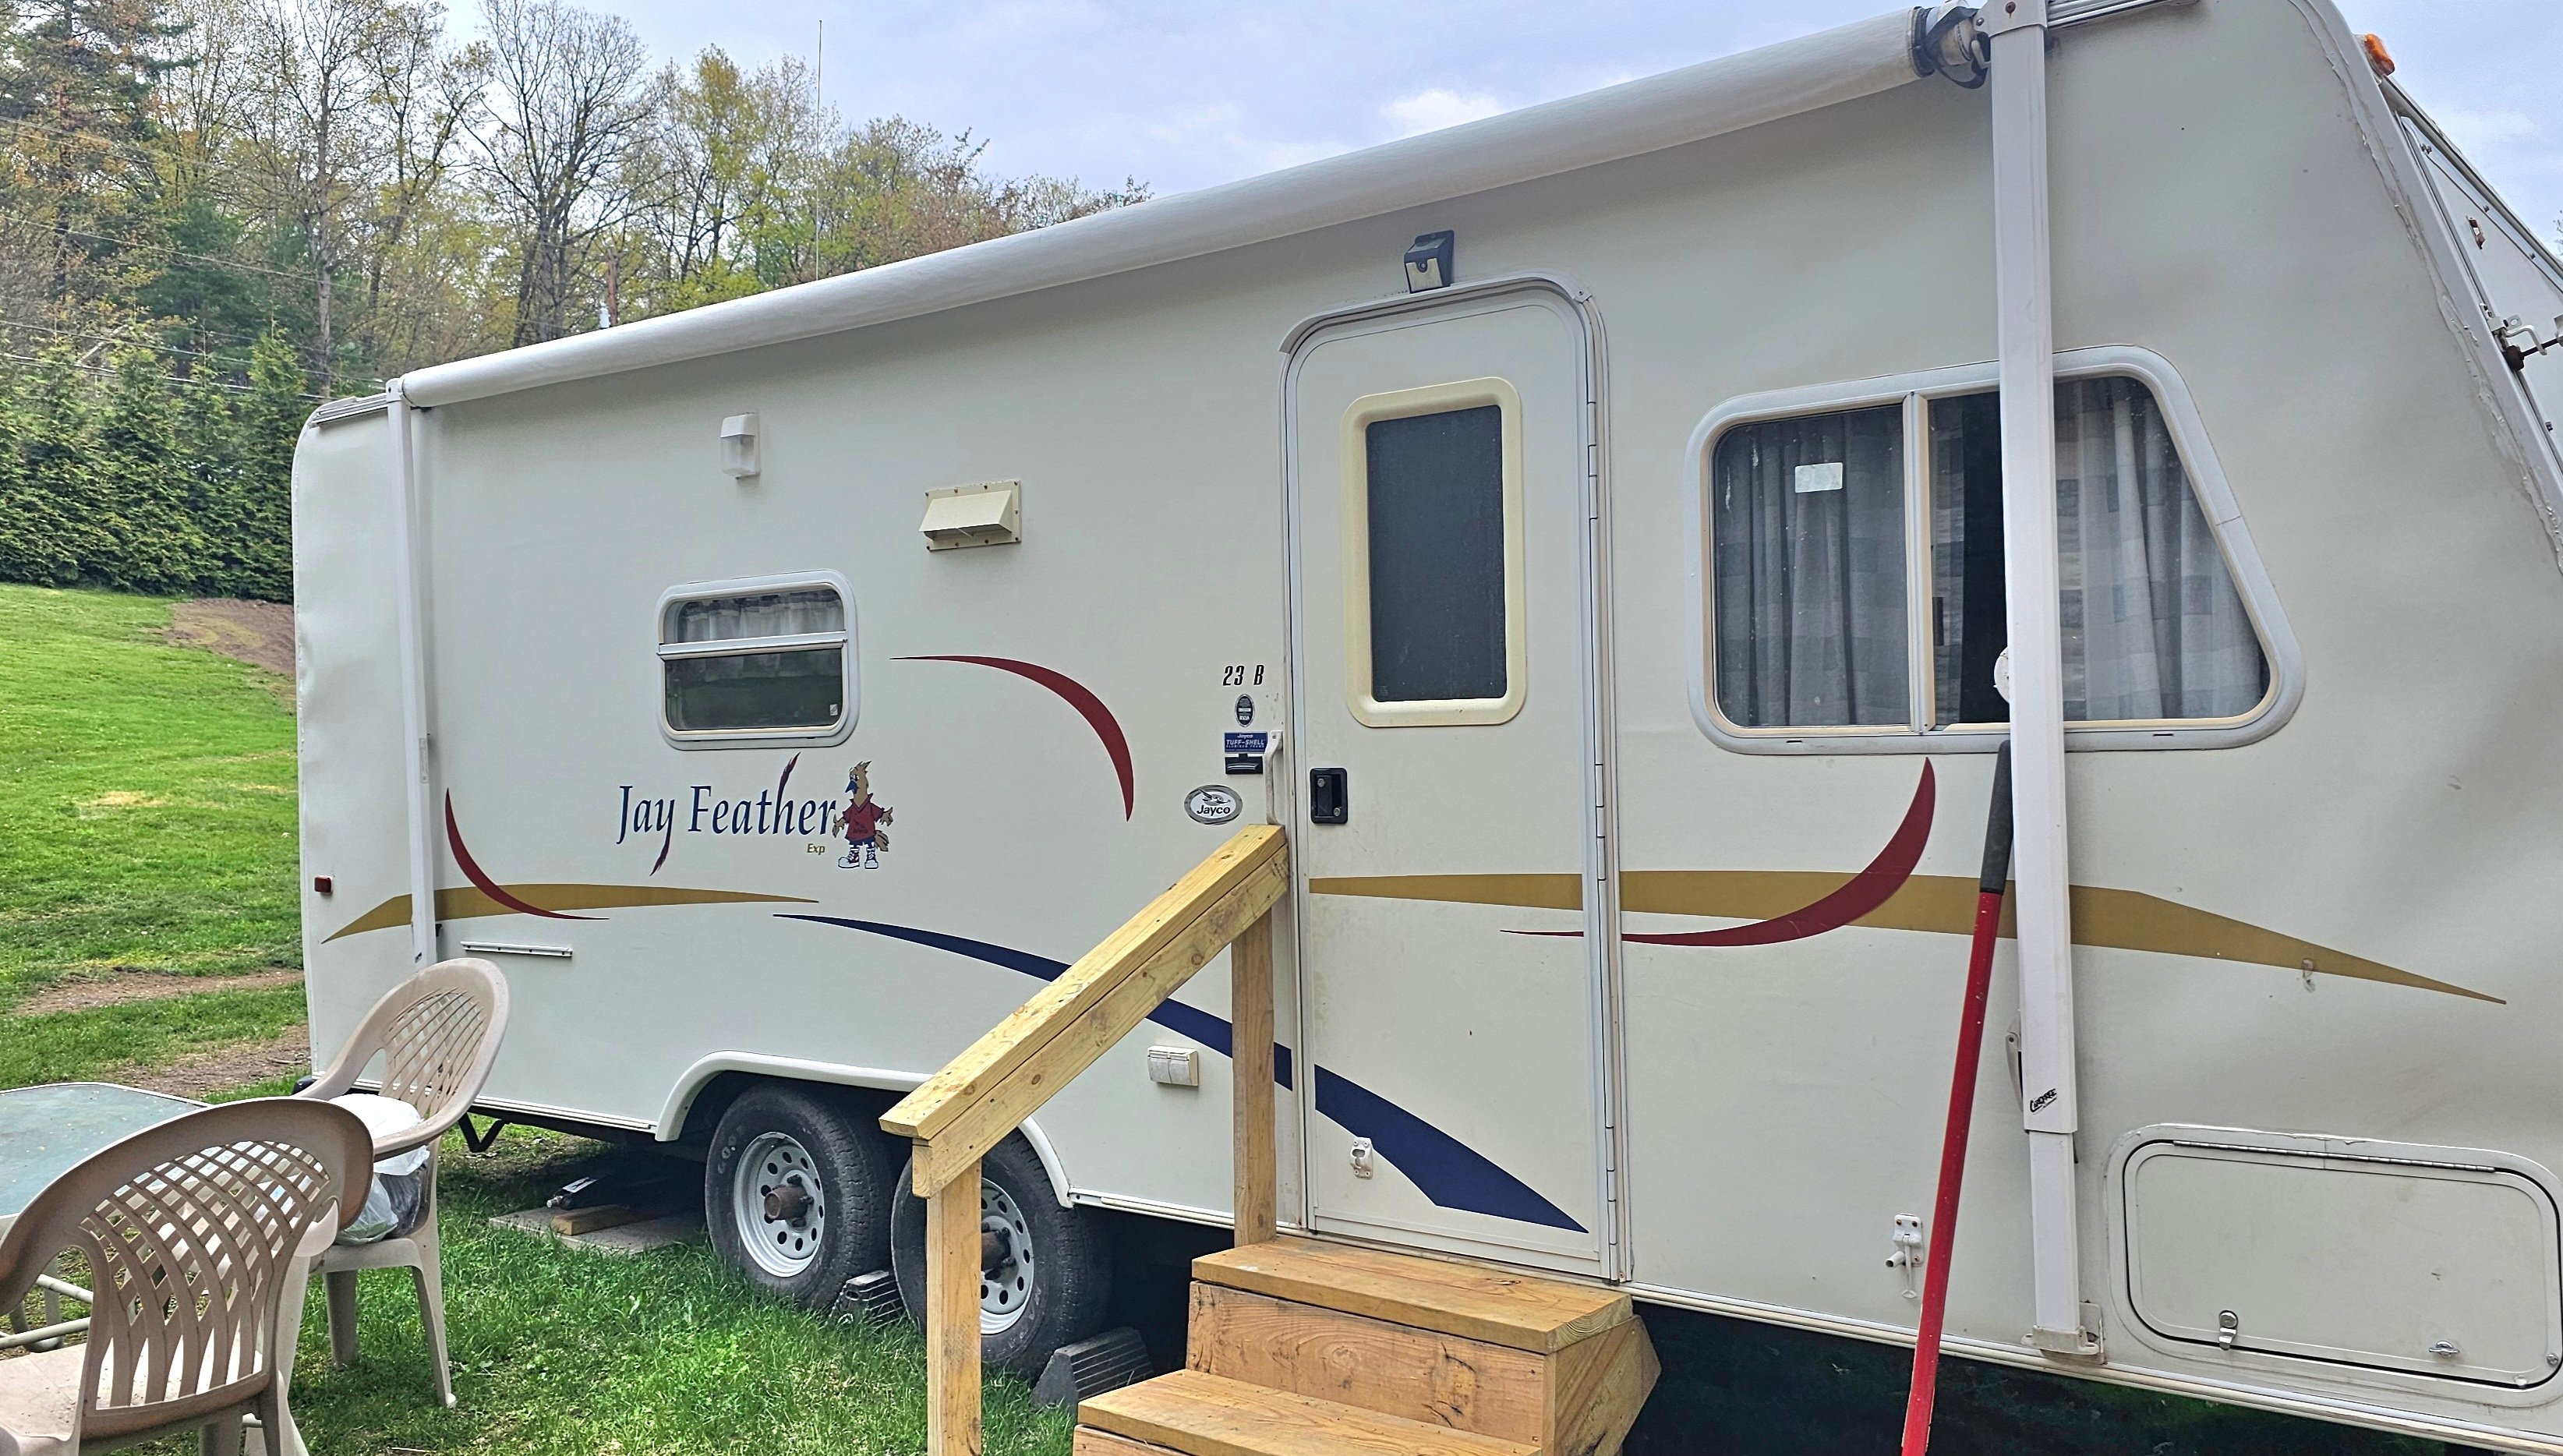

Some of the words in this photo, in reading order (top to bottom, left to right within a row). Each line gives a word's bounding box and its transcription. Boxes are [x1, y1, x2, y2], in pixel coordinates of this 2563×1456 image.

[1222, 665, 1245, 686] 23
[1253, 664, 1264, 686] B
[617, 785, 675, 876] Jay
[688, 751, 836, 836] Feather
[1197, 804, 1231, 817] Jayco
[807, 843, 825, 856] Exp
